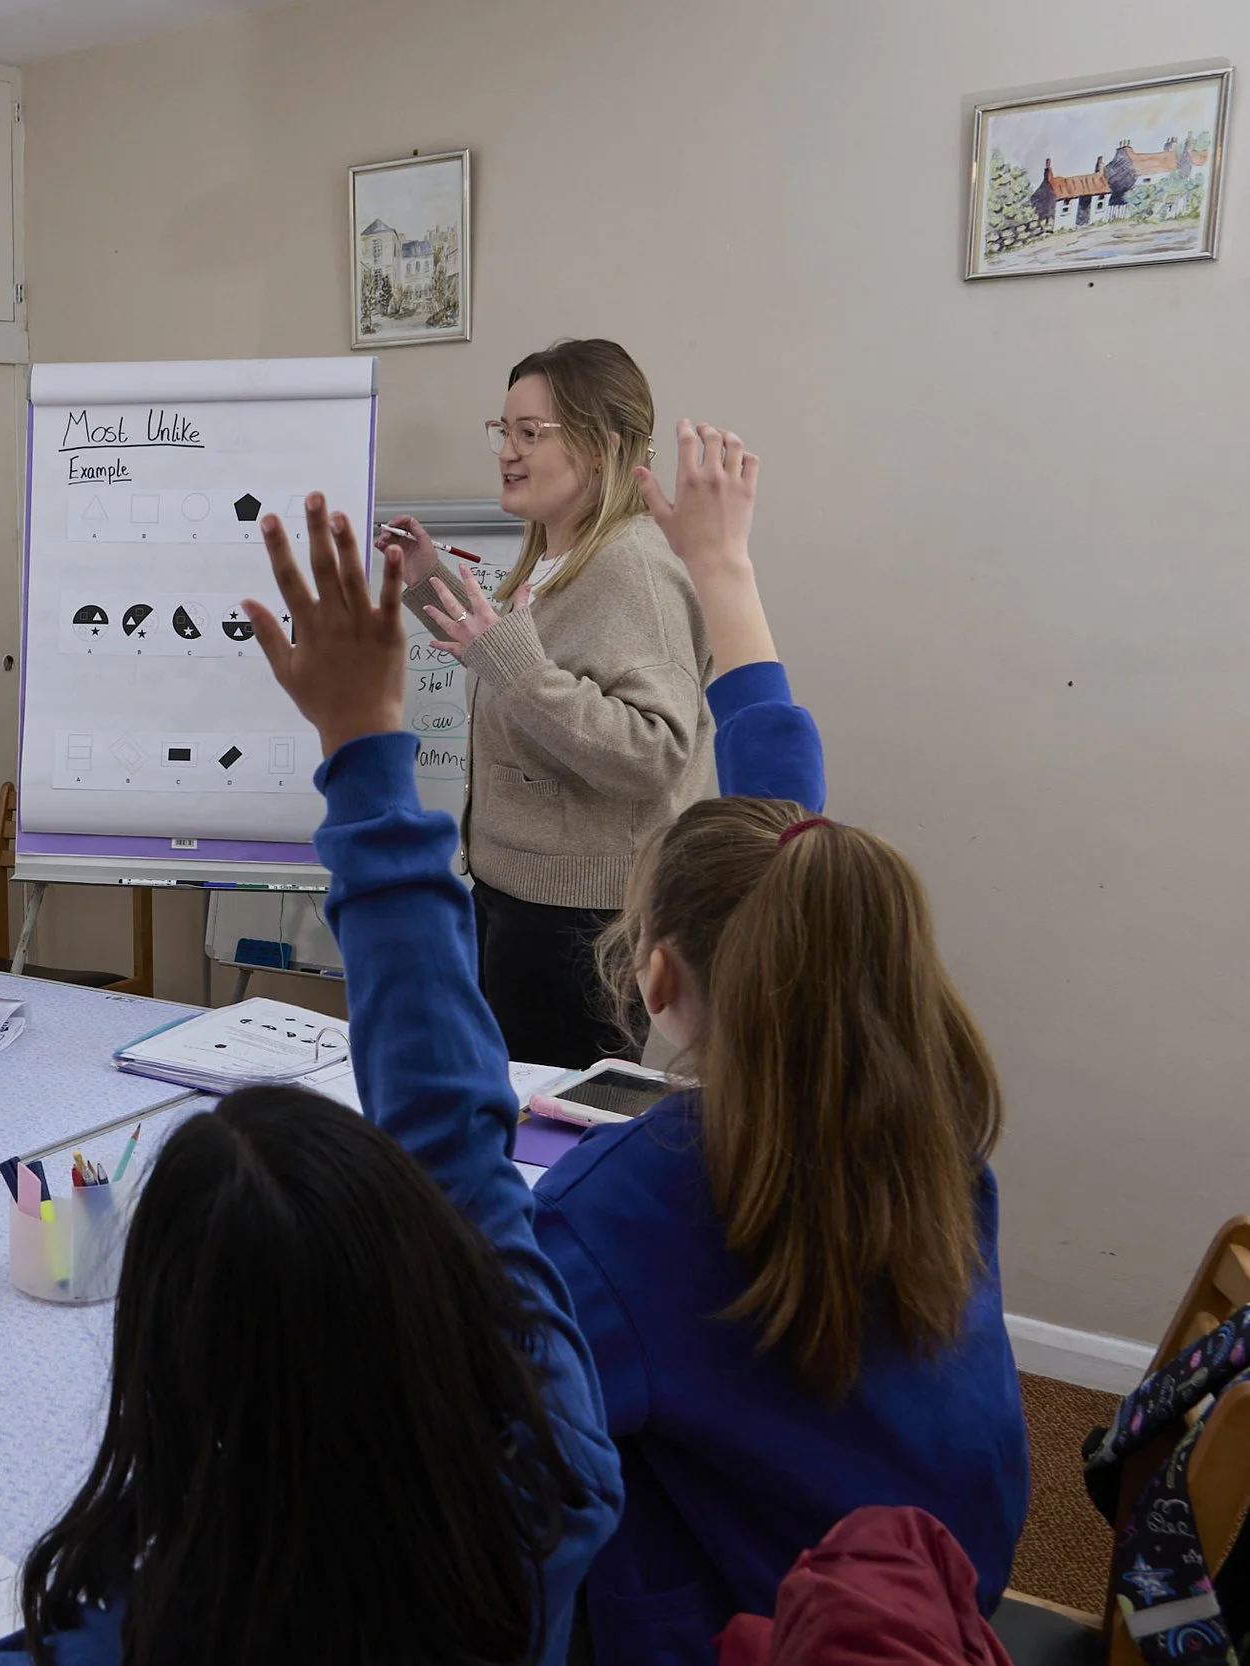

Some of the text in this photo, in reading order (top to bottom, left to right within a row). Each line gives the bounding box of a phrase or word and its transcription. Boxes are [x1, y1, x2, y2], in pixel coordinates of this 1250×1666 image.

[62, 408, 201, 446] Most Unlike
[69, 455, 130, 485] Example
[409, 644, 456, 664] axe
